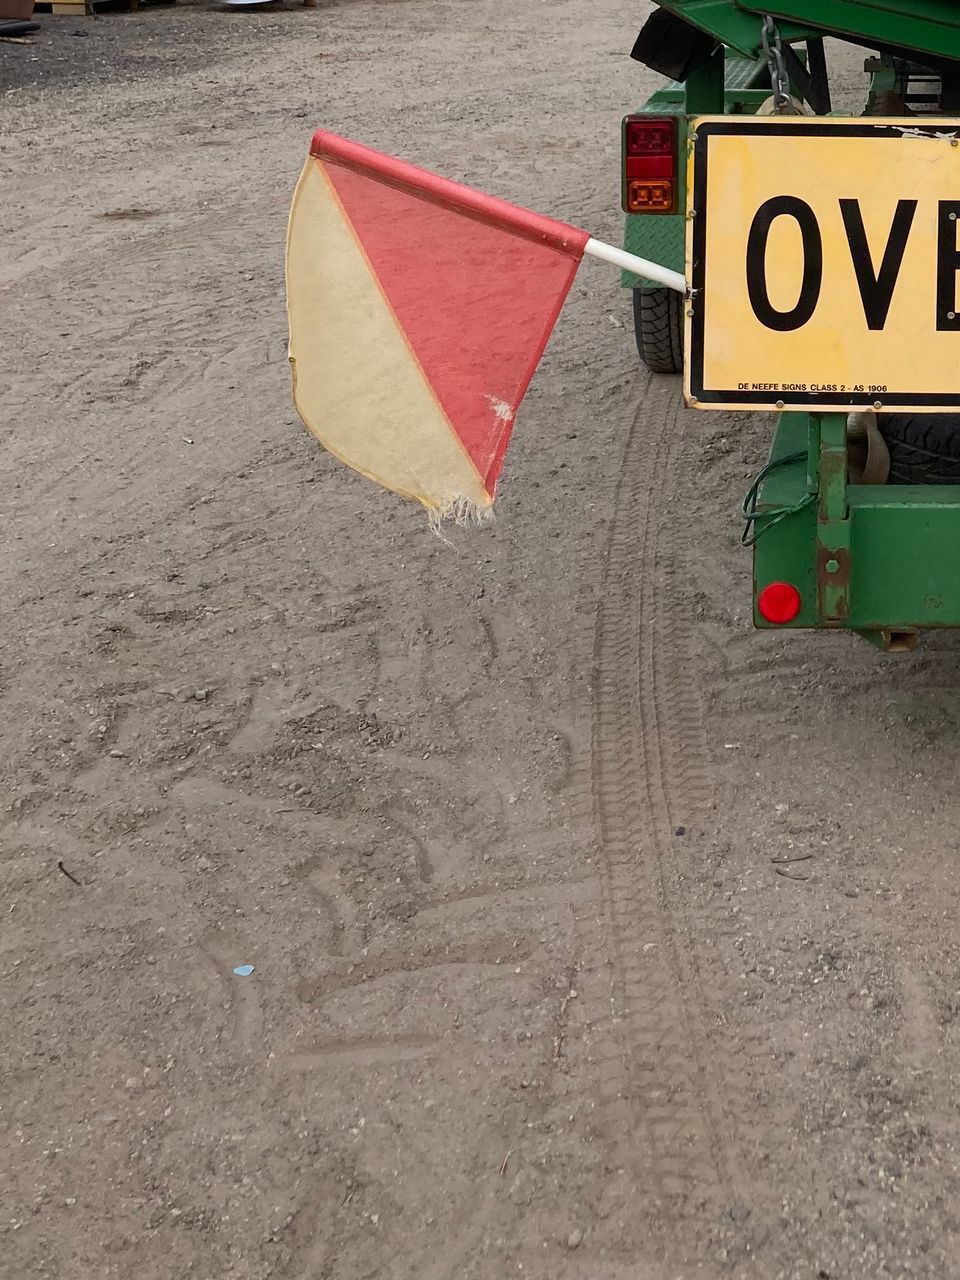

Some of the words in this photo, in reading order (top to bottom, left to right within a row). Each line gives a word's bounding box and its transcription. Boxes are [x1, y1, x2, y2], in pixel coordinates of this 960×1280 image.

[737, 382, 750, 390] DE
[751, 383, 779, 391] NEEFE
[781, 383, 807, 391] SIGNS
[810, 384, 838, 392] CLASS
[840, 384, 846, 392] 2
[853, 385, 864, 393] AS
[868, 384, 888, 393] 1906
